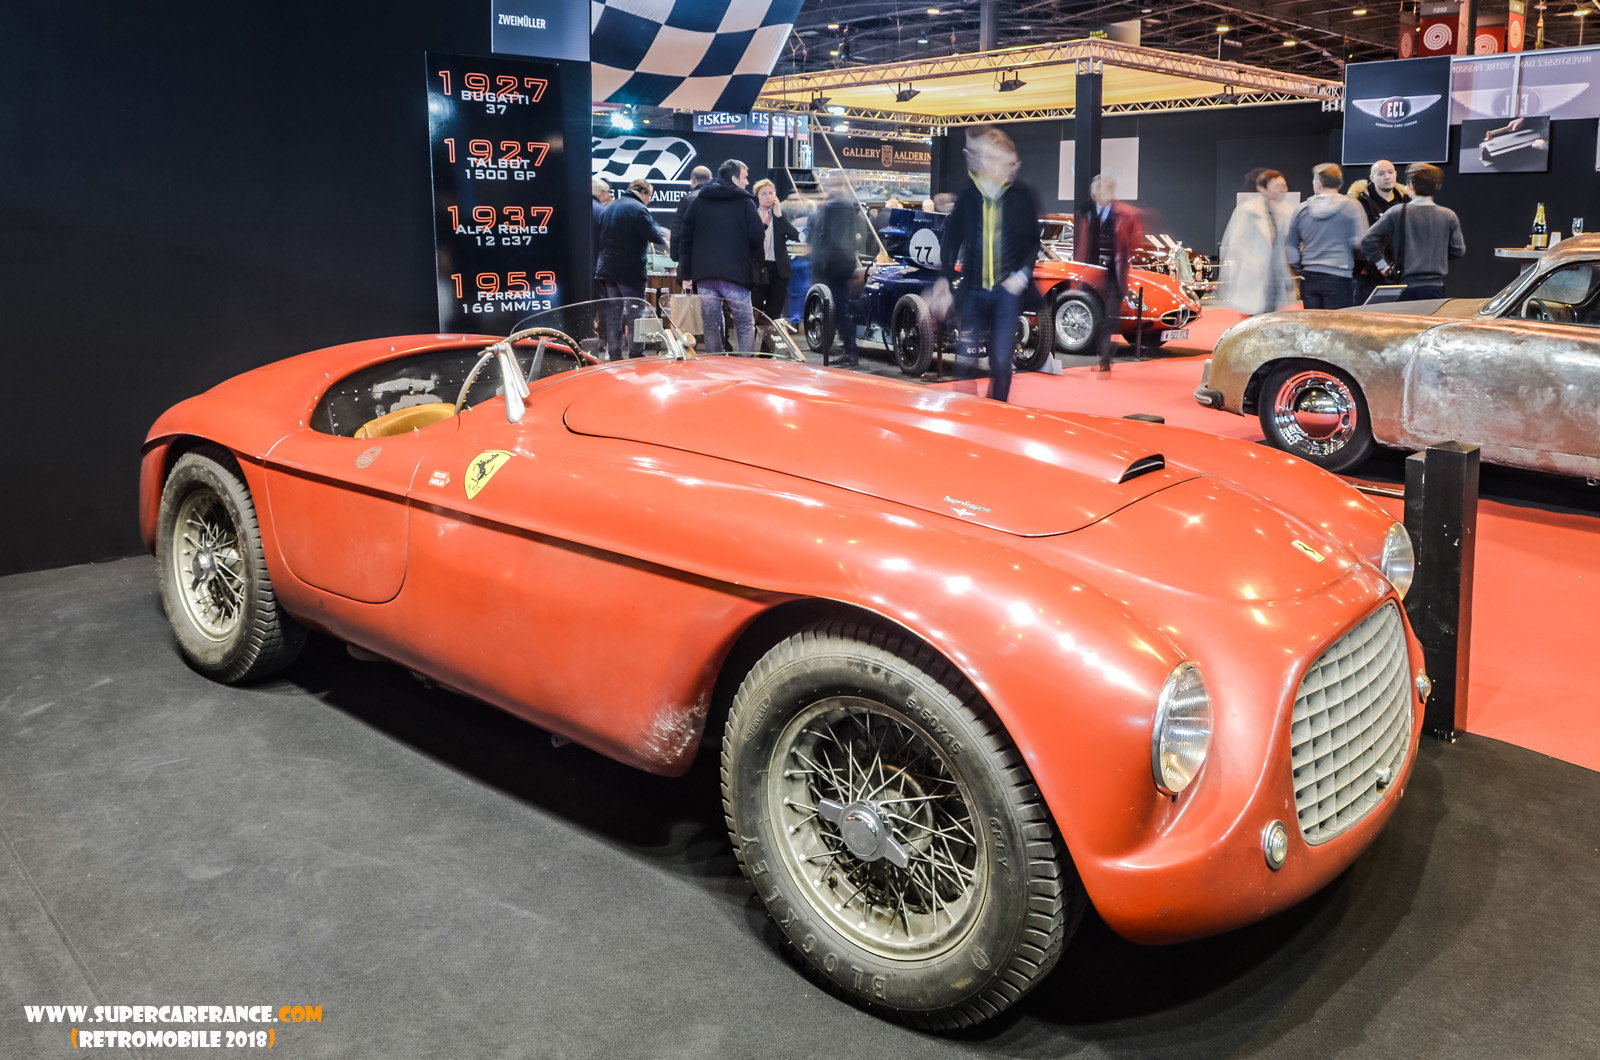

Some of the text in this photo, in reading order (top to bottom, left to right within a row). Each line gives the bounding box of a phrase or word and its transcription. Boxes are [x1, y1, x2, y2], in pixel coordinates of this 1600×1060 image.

[498, 14, 546, 29] ZWEIMÜLLER
[438, 70, 548, 102] 1927
[461, 90, 529, 105] BUGATTI
[486, 103, 507, 115] 37
[1387, 101, 1405, 118] ECL
[697, 112, 741, 126] FISKENS
[444, 138, 550, 167] 1927
[842, 146, 931, 162] GALLERY AALDERIN
[467, 157, 530, 169] TALBOT
[465, 169, 536, 181] 1500 GP
[447, 205, 554, 231] 1937
[455, 224, 548, 235] ALFA ROMEO
[476, 235, 496, 246] 12
[914, 246, 934, 265] 77
[451, 271, 557, 299] 1953
[477, 291, 535, 301] FERRARI
[463, 300, 552, 314] 166 MM/53
[746, 701, 770, 738] SPECIAL
[742, 834, 887, 1000] BLOCKLEY
